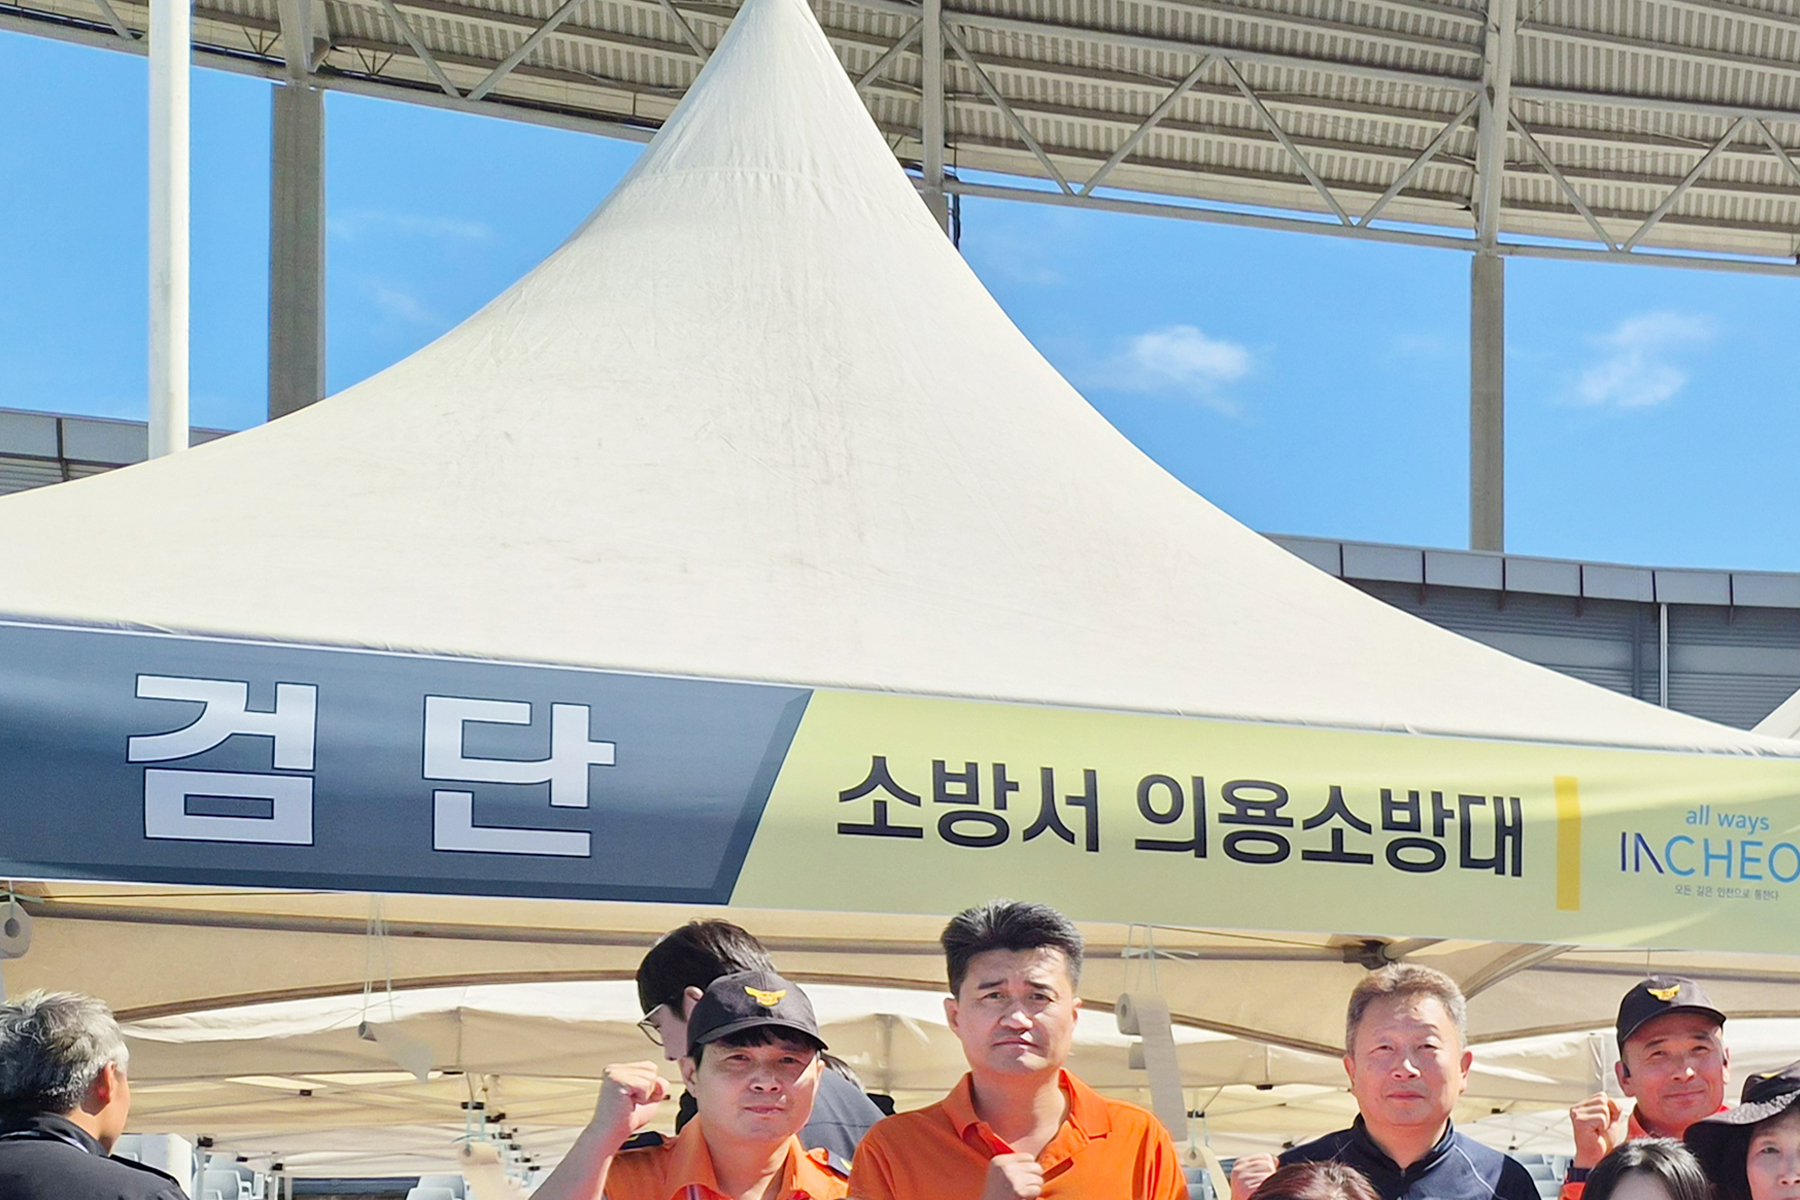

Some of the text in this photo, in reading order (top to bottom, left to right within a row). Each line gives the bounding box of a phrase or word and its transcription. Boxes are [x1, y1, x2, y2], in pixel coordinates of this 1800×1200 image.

[836, 754, 1099, 853] 소방서
[1134, 773, 1524, 878] 의용소방대
[1685, 804, 1770, 835] all ways
